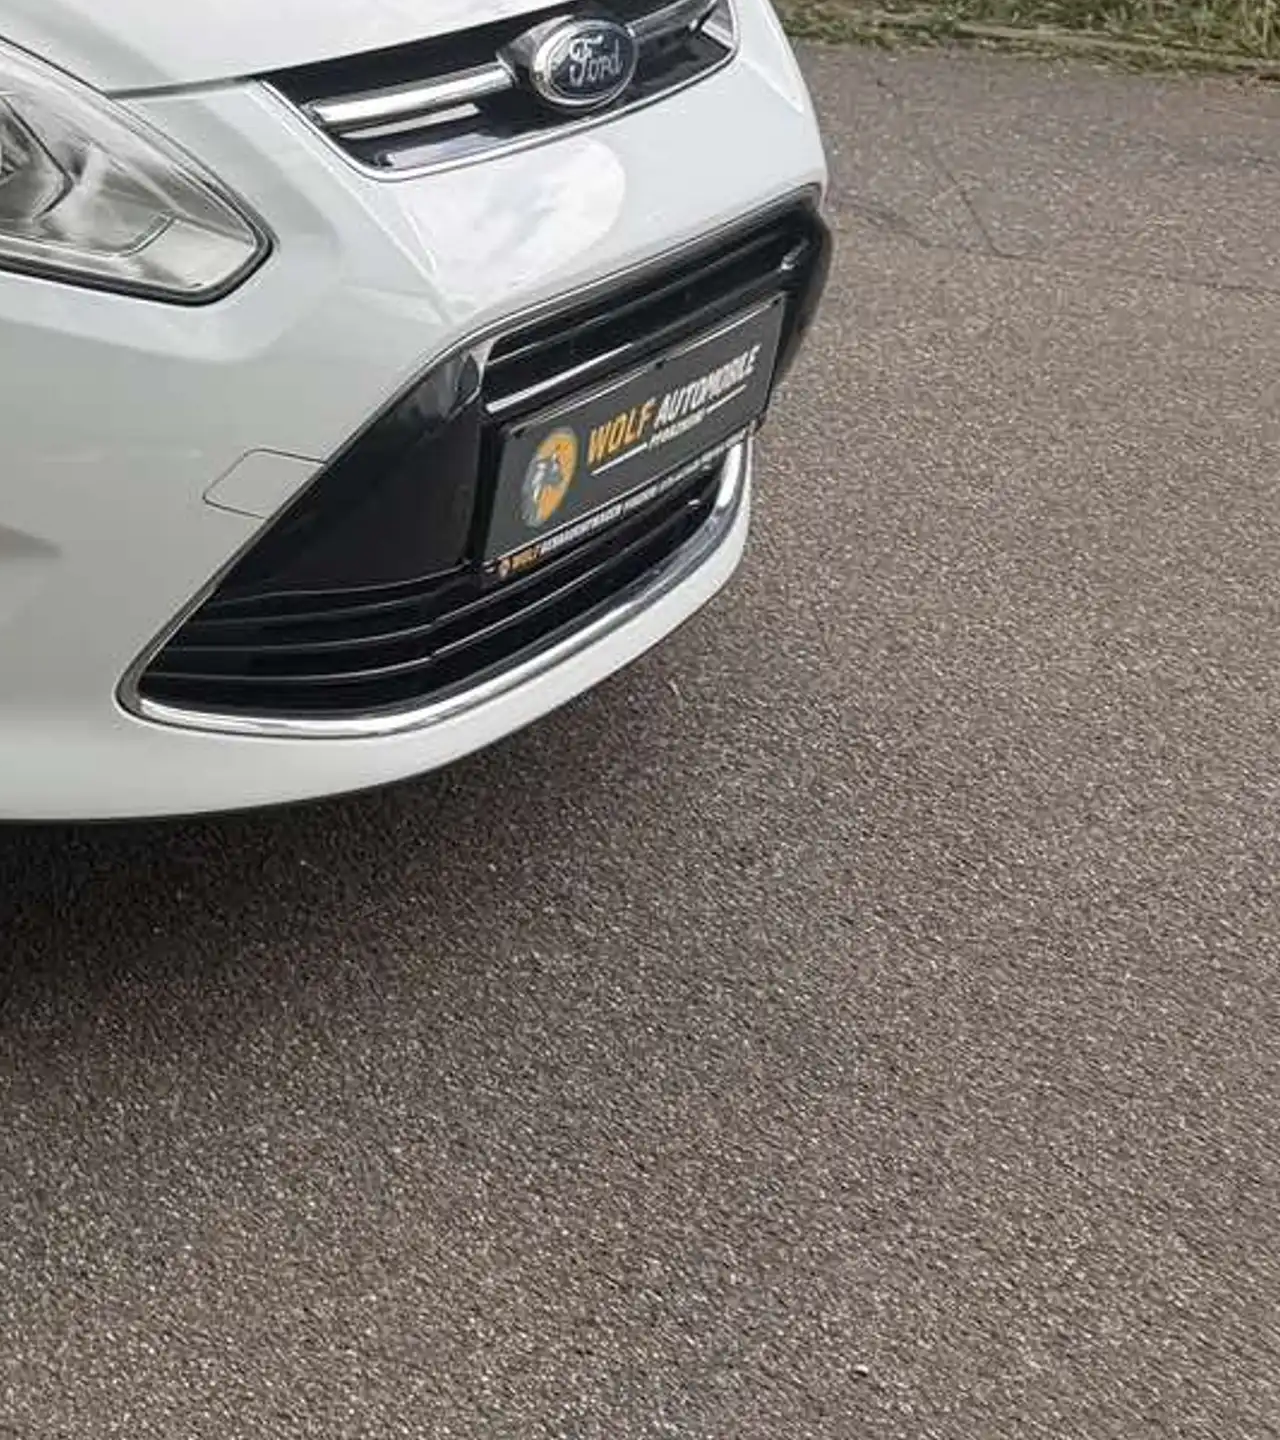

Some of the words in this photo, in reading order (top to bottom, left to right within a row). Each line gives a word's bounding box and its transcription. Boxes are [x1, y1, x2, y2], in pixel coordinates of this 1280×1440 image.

[567, 33, 624, 88] Ford
[587, 396, 658, 467] WOLF
[653, 343, 762, 431] AUTOMOBILE
